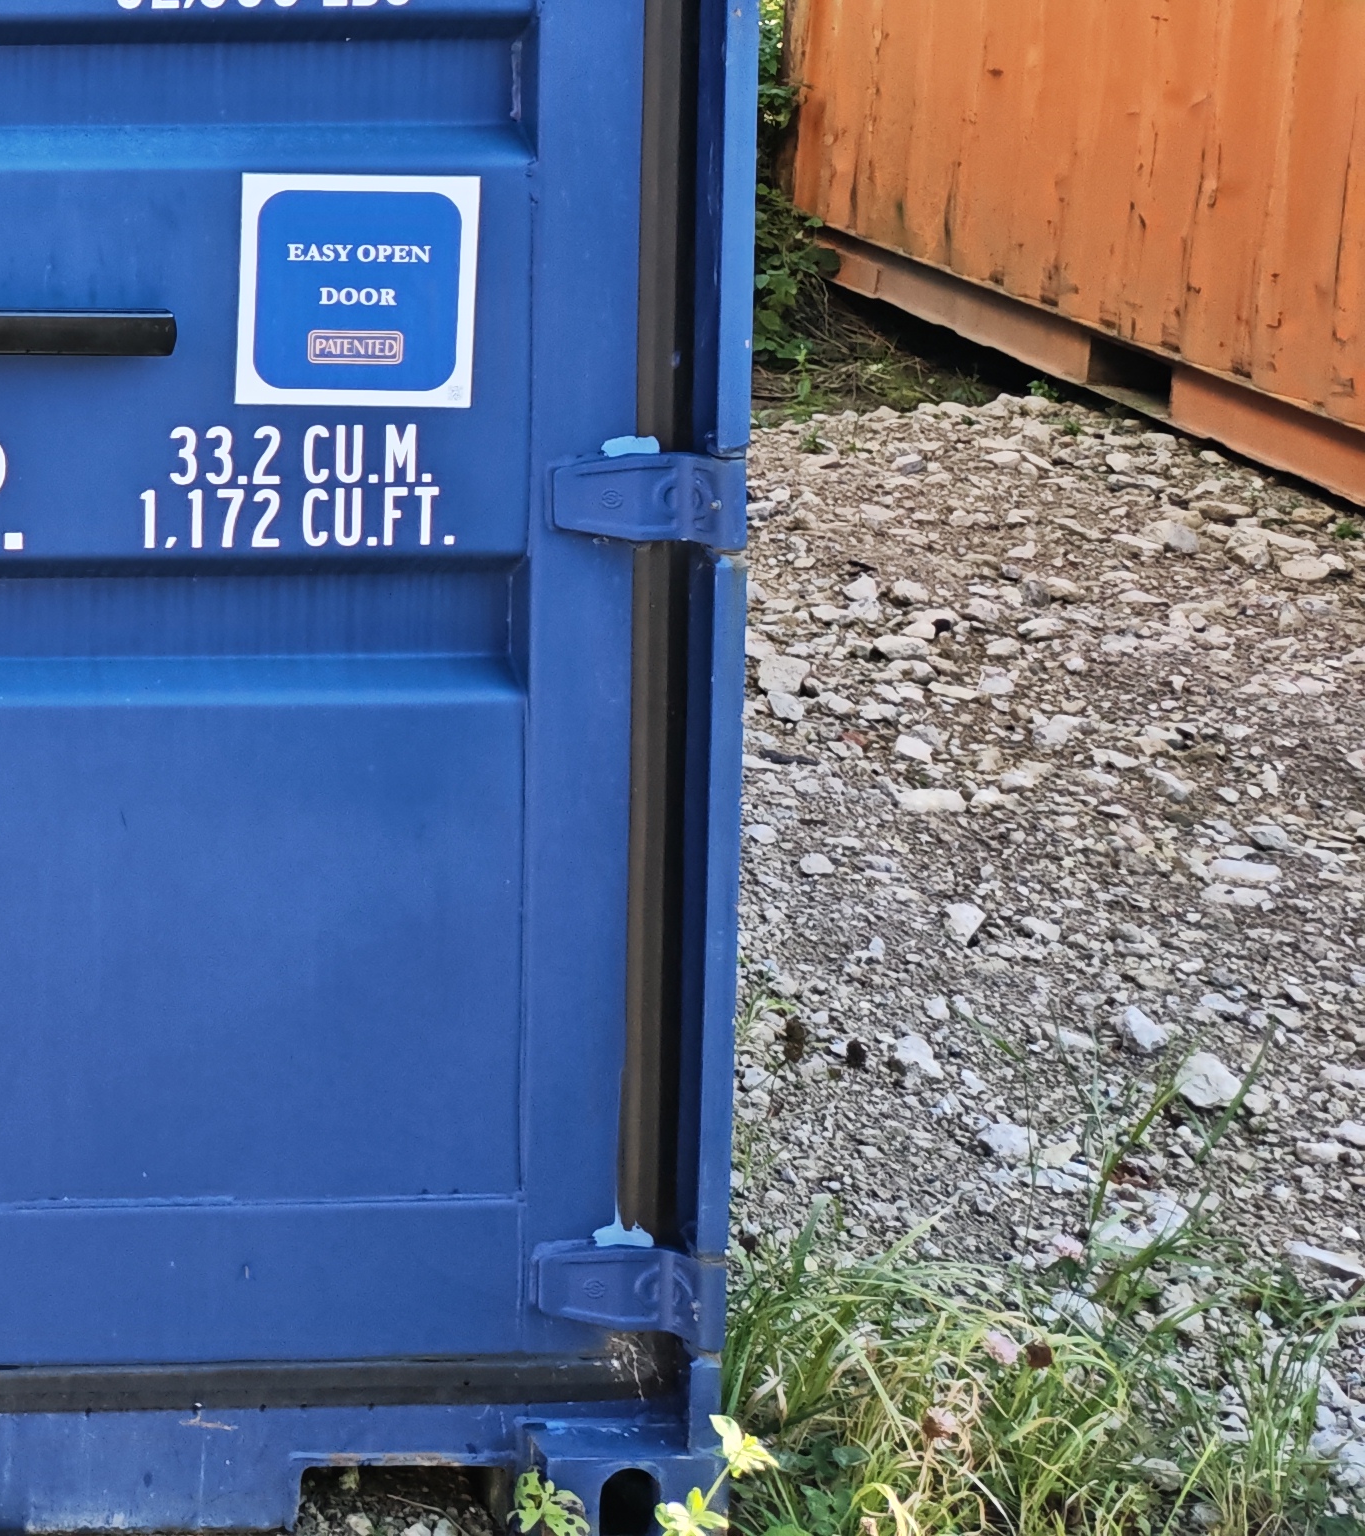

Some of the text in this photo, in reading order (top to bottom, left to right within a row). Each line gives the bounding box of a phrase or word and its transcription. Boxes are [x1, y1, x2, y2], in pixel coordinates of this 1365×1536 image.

[287, 244, 431, 263] EASY OPEN
[319, 287, 397, 305] DOOR
[315, 338, 398, 356] PATENTED
[170, 423, 432, 485] 33.2 CU.M.
[139, 486, 455, 548] 1,172 CU.FT.
